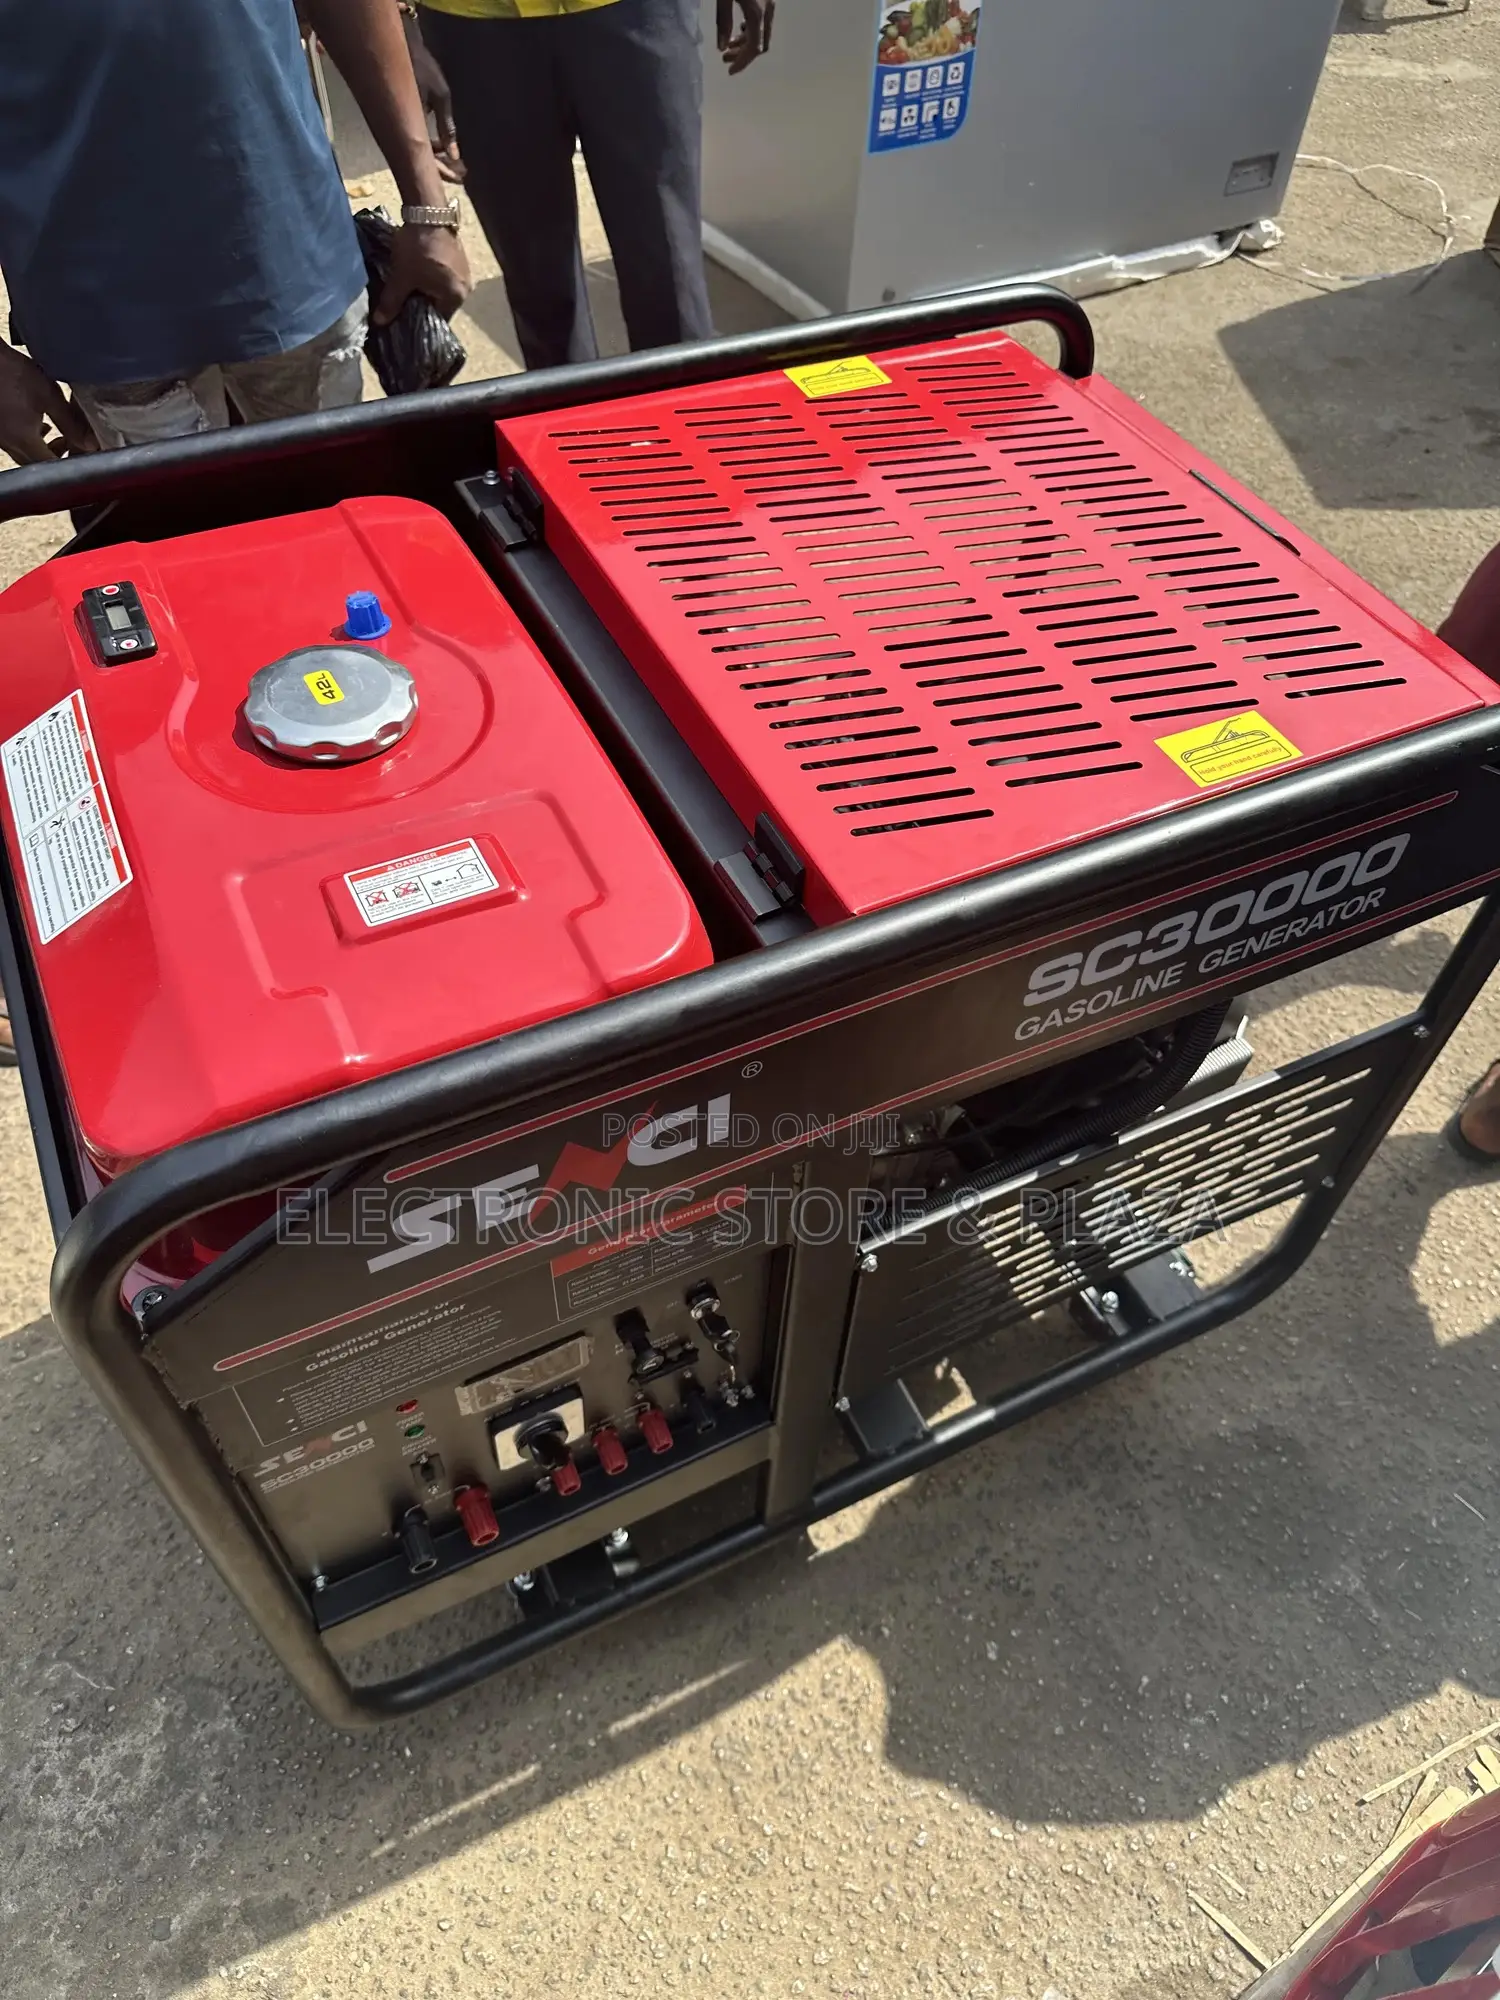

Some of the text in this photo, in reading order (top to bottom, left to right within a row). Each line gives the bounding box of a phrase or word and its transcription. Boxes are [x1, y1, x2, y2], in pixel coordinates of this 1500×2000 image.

[316, 673, 336, 699] 42L
[1234, 755, 1252, 766] hand
[1253, 746, 1283, 759] carefully
[395, 852, 438, 868] DANGER
[1022, 832, 1411, 1007] SC30000
[1014, 887, 1386, 1041] GASOLINE GENERATOR
[305, 1303, 467, 1372] Gasoline Generator
[260, 1437, 375, 1489] SC30000
